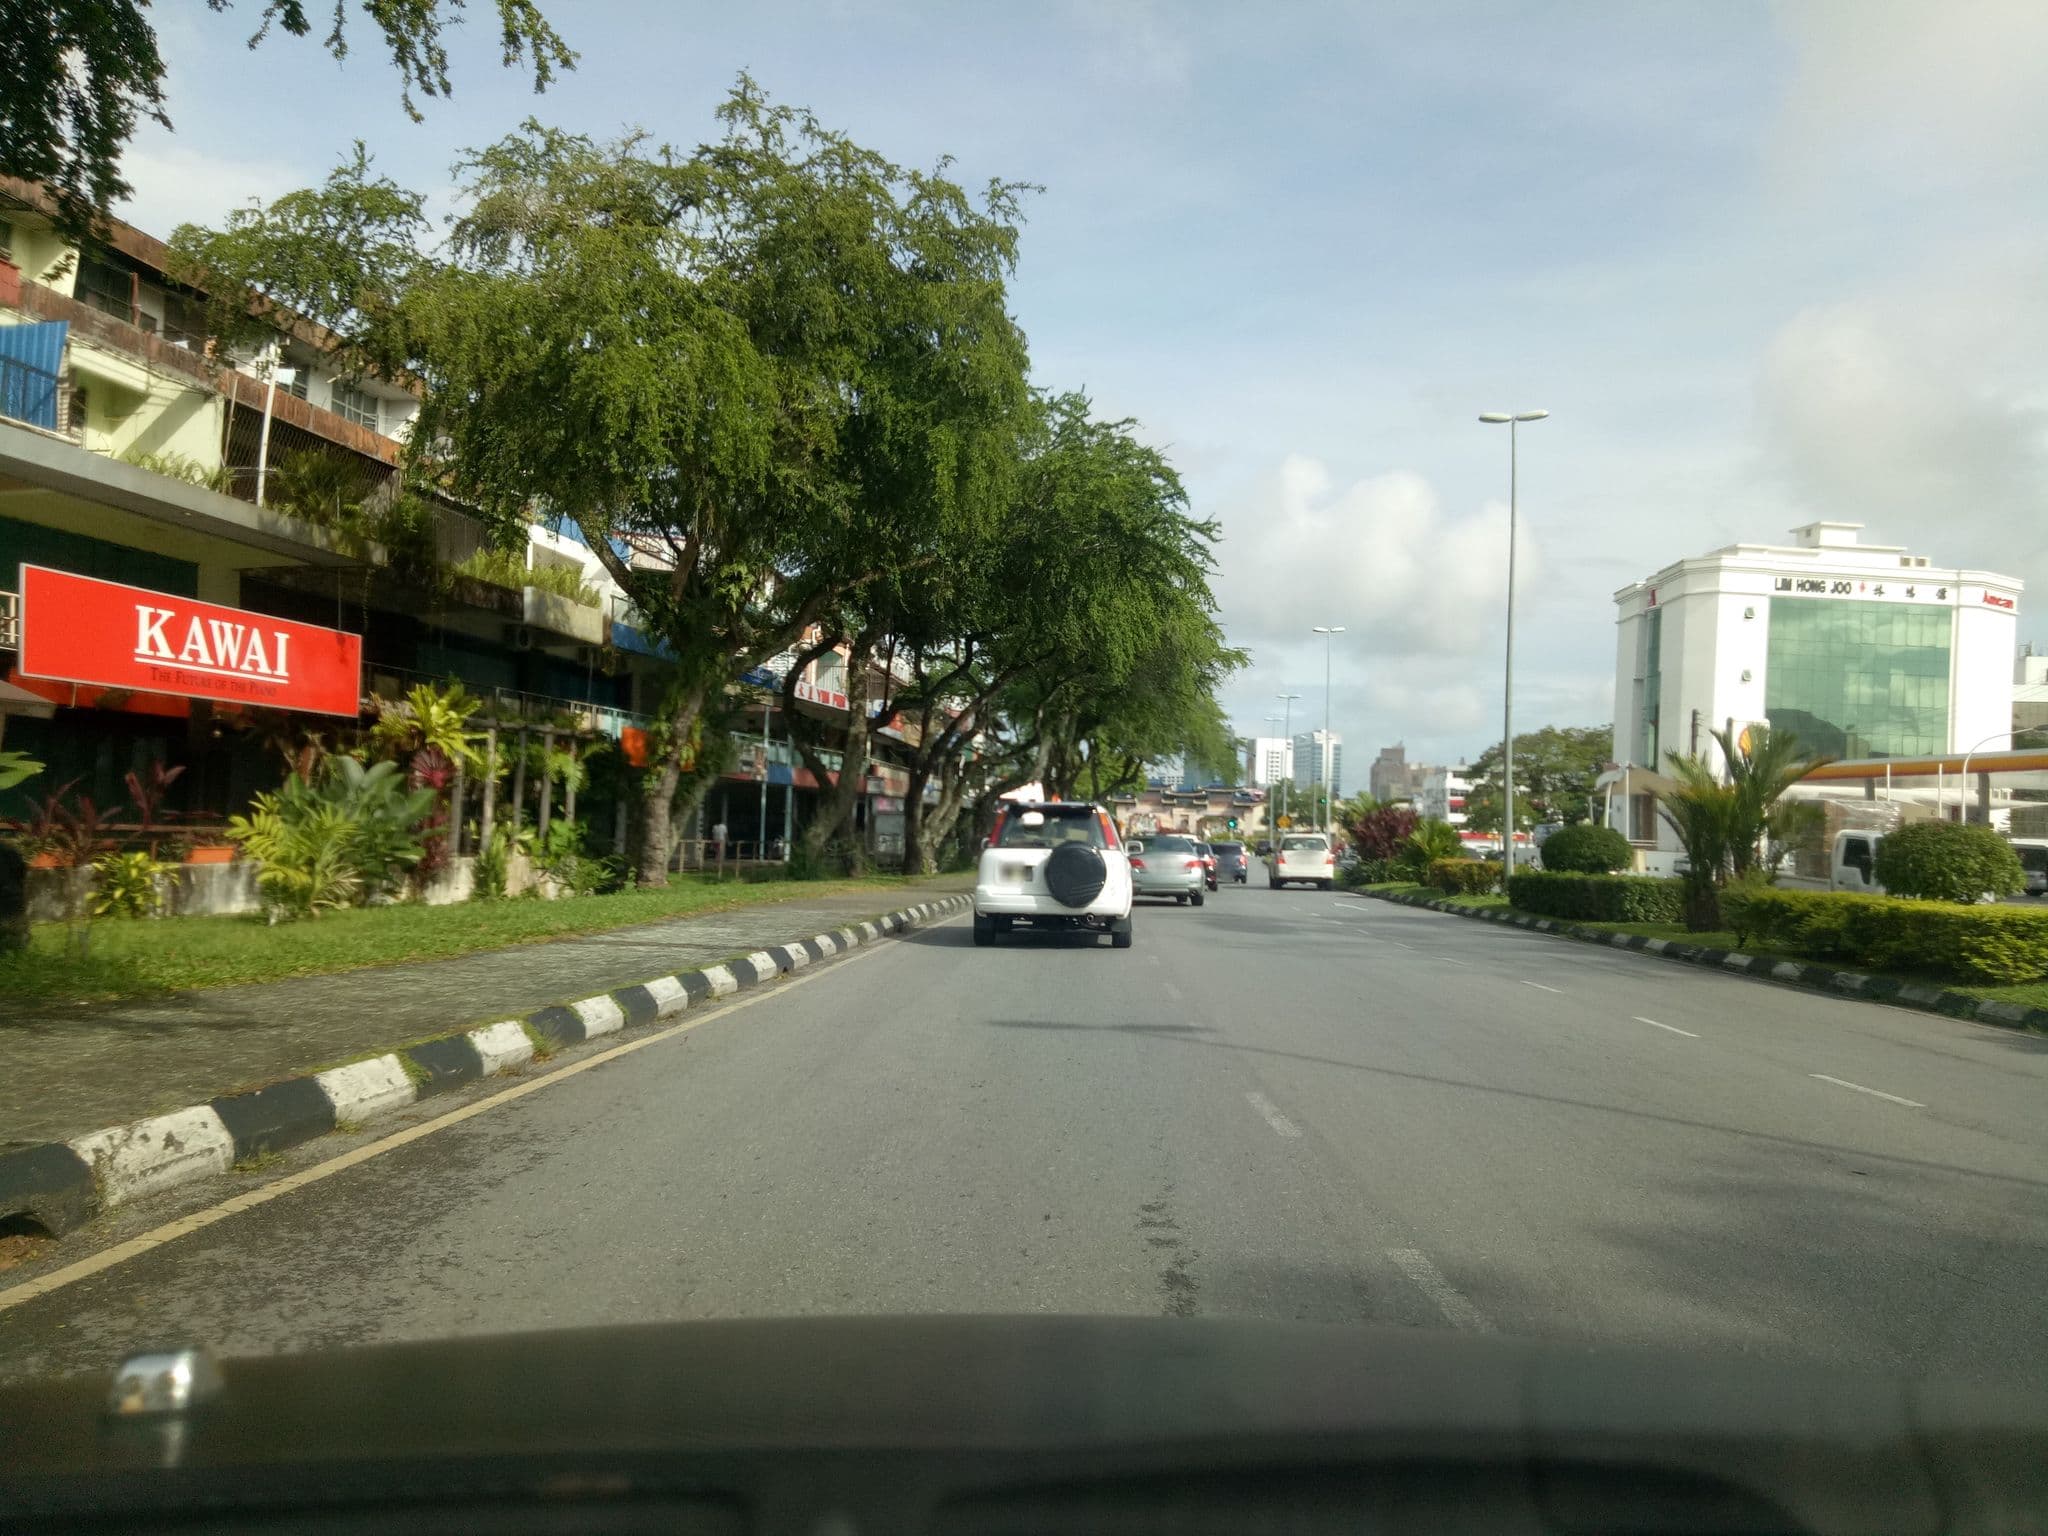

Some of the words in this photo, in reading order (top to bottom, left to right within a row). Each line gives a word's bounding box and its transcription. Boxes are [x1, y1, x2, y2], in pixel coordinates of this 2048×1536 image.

[1775, 577, 1792, 591] LIM
[1796, 579, 1826, 593] HONG
[1830, 581, 1852, 595] JOO
[134, 605, 290, 676] KAWAI
